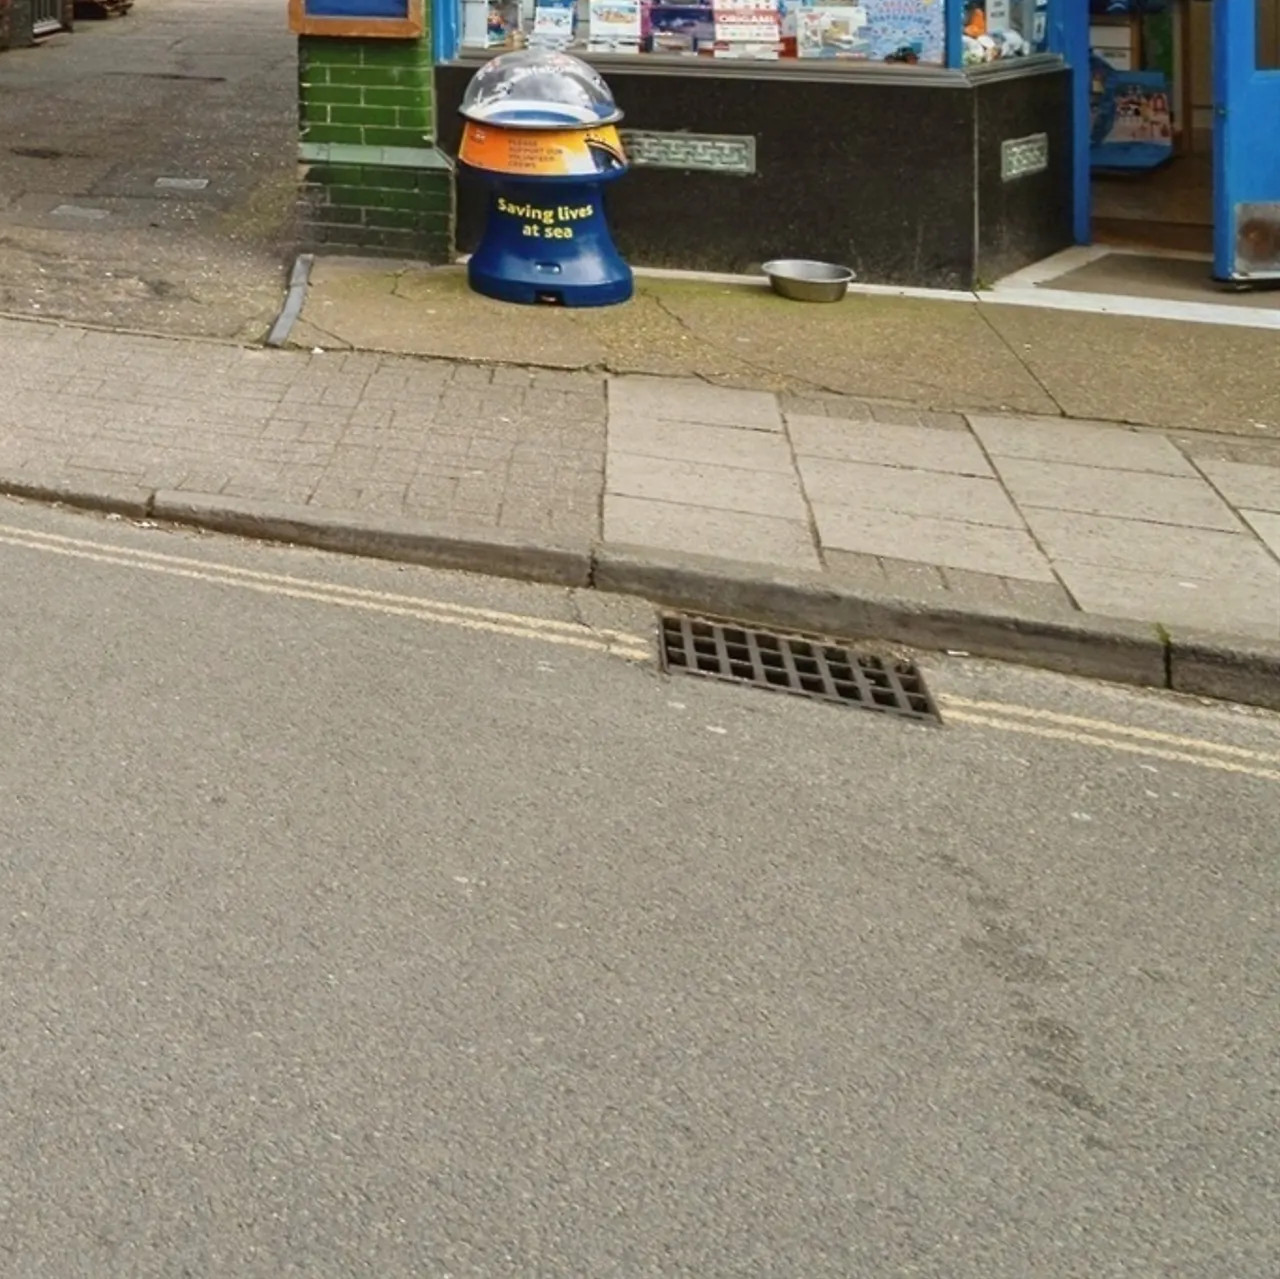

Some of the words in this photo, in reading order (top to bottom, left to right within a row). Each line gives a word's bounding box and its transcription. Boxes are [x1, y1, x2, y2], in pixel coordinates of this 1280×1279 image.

[497, 197, 555, 225] Saving
[557, 202, 594, 221] lives
[522, 223, 540, 237] at
[544, 225, 573, 239] sea
